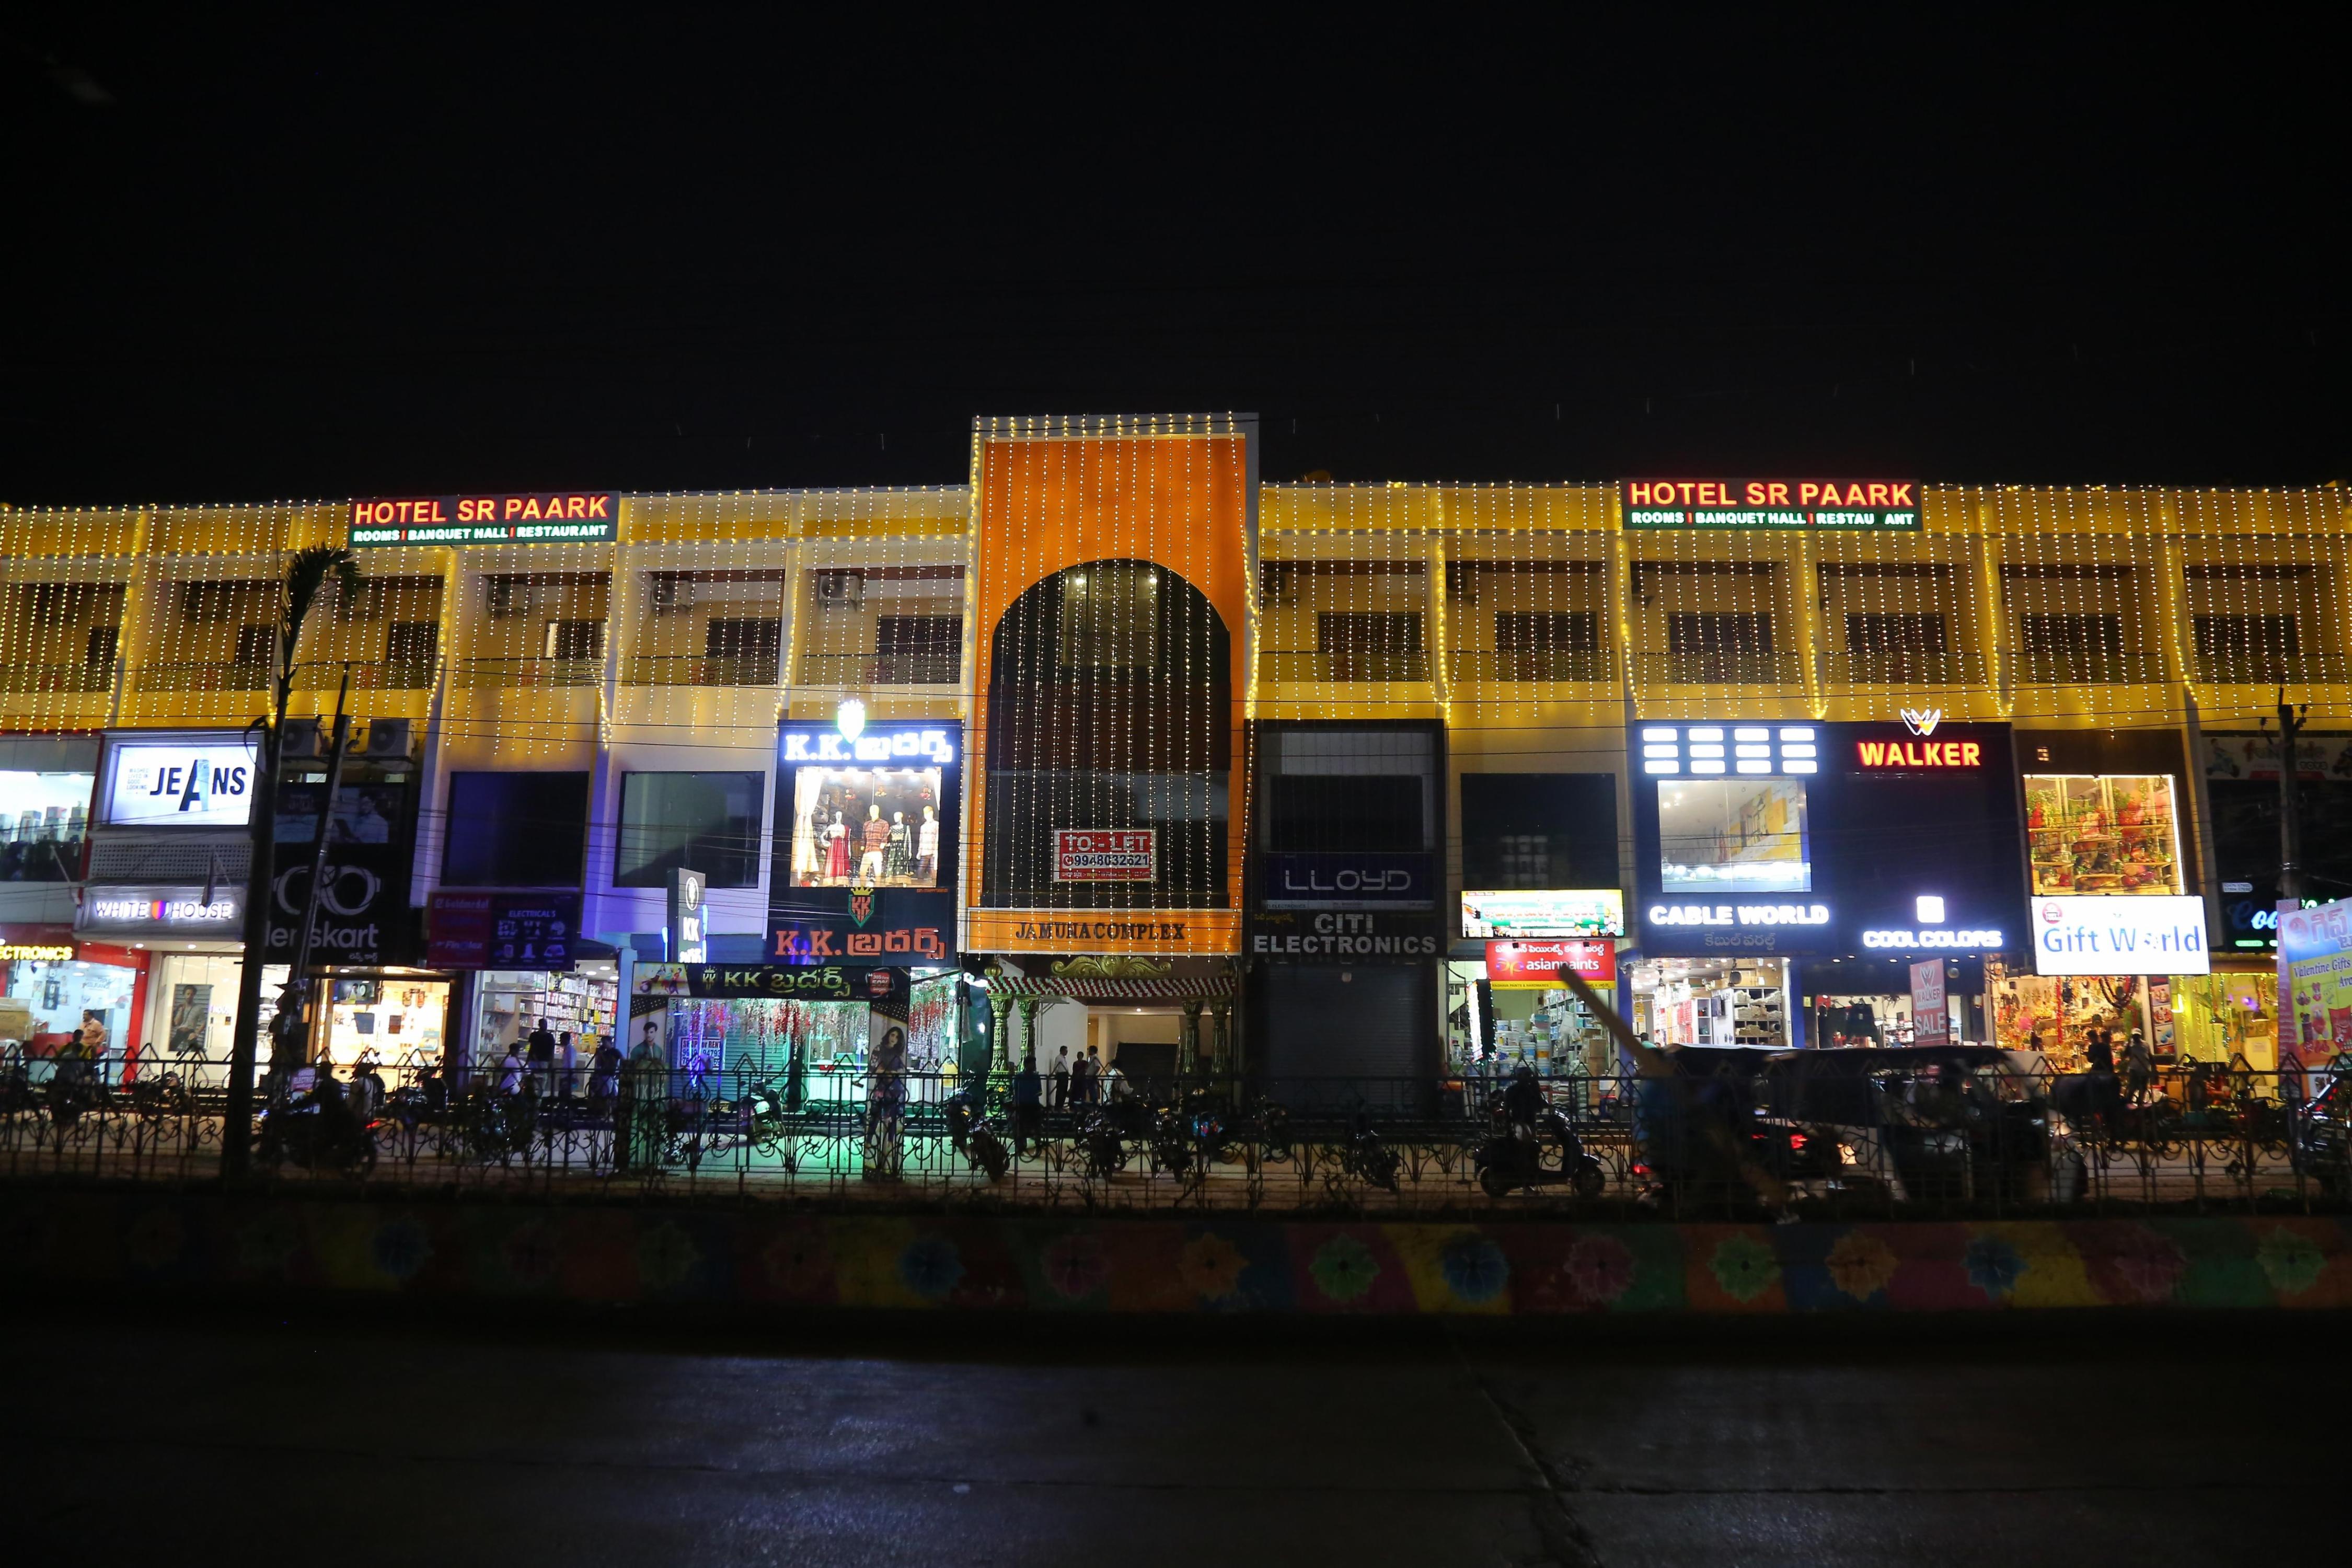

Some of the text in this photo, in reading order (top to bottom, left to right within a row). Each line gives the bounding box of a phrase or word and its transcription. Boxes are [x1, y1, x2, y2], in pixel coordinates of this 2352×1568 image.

[1630, 482, 1914, 506] HOTEL SR PAARK
[355, 495, 609, 524] HOTEL SR PAARK
[1631, 512, 1914, 525] ROOMS BANQUET HALL RESTAUANT
[353, 524, 608, 542] ROOMS BANQUET HALL RESTAURANT
[1858, 742, 1981, 767] WALKER
[149, 759, 246, 811] JEANS
[1065, 836, 1092, 851] TO
[1111, 836, 1148, 851] LET
[1285, 870, 1411, 891] LLOYD
[95, 902, 234, 919] WHITE HOUSE
[1649, 905, 1830, 925] CABLE WORLD
[683, 917, 700, 942] KK
[1016, 922, 1185, 940] JAMUNA COMPLEX
[1315, 914, 1374, 934] CITI
[775, 930, 843, 956] K.K.
[1254, 936, 1436, 954] ELECTRONICS
[1863, 930, 2003, 948] COOL COLORS
[2043, 925, 2200, 952] Gift Wrld
[2293, 957, 2351, 978] Valentine Gifts
[724, 971, 762, 987] KK
[1915, 988, 1941, 1004] WALKER
[1915, 1012, 1946, 1036] SALE
